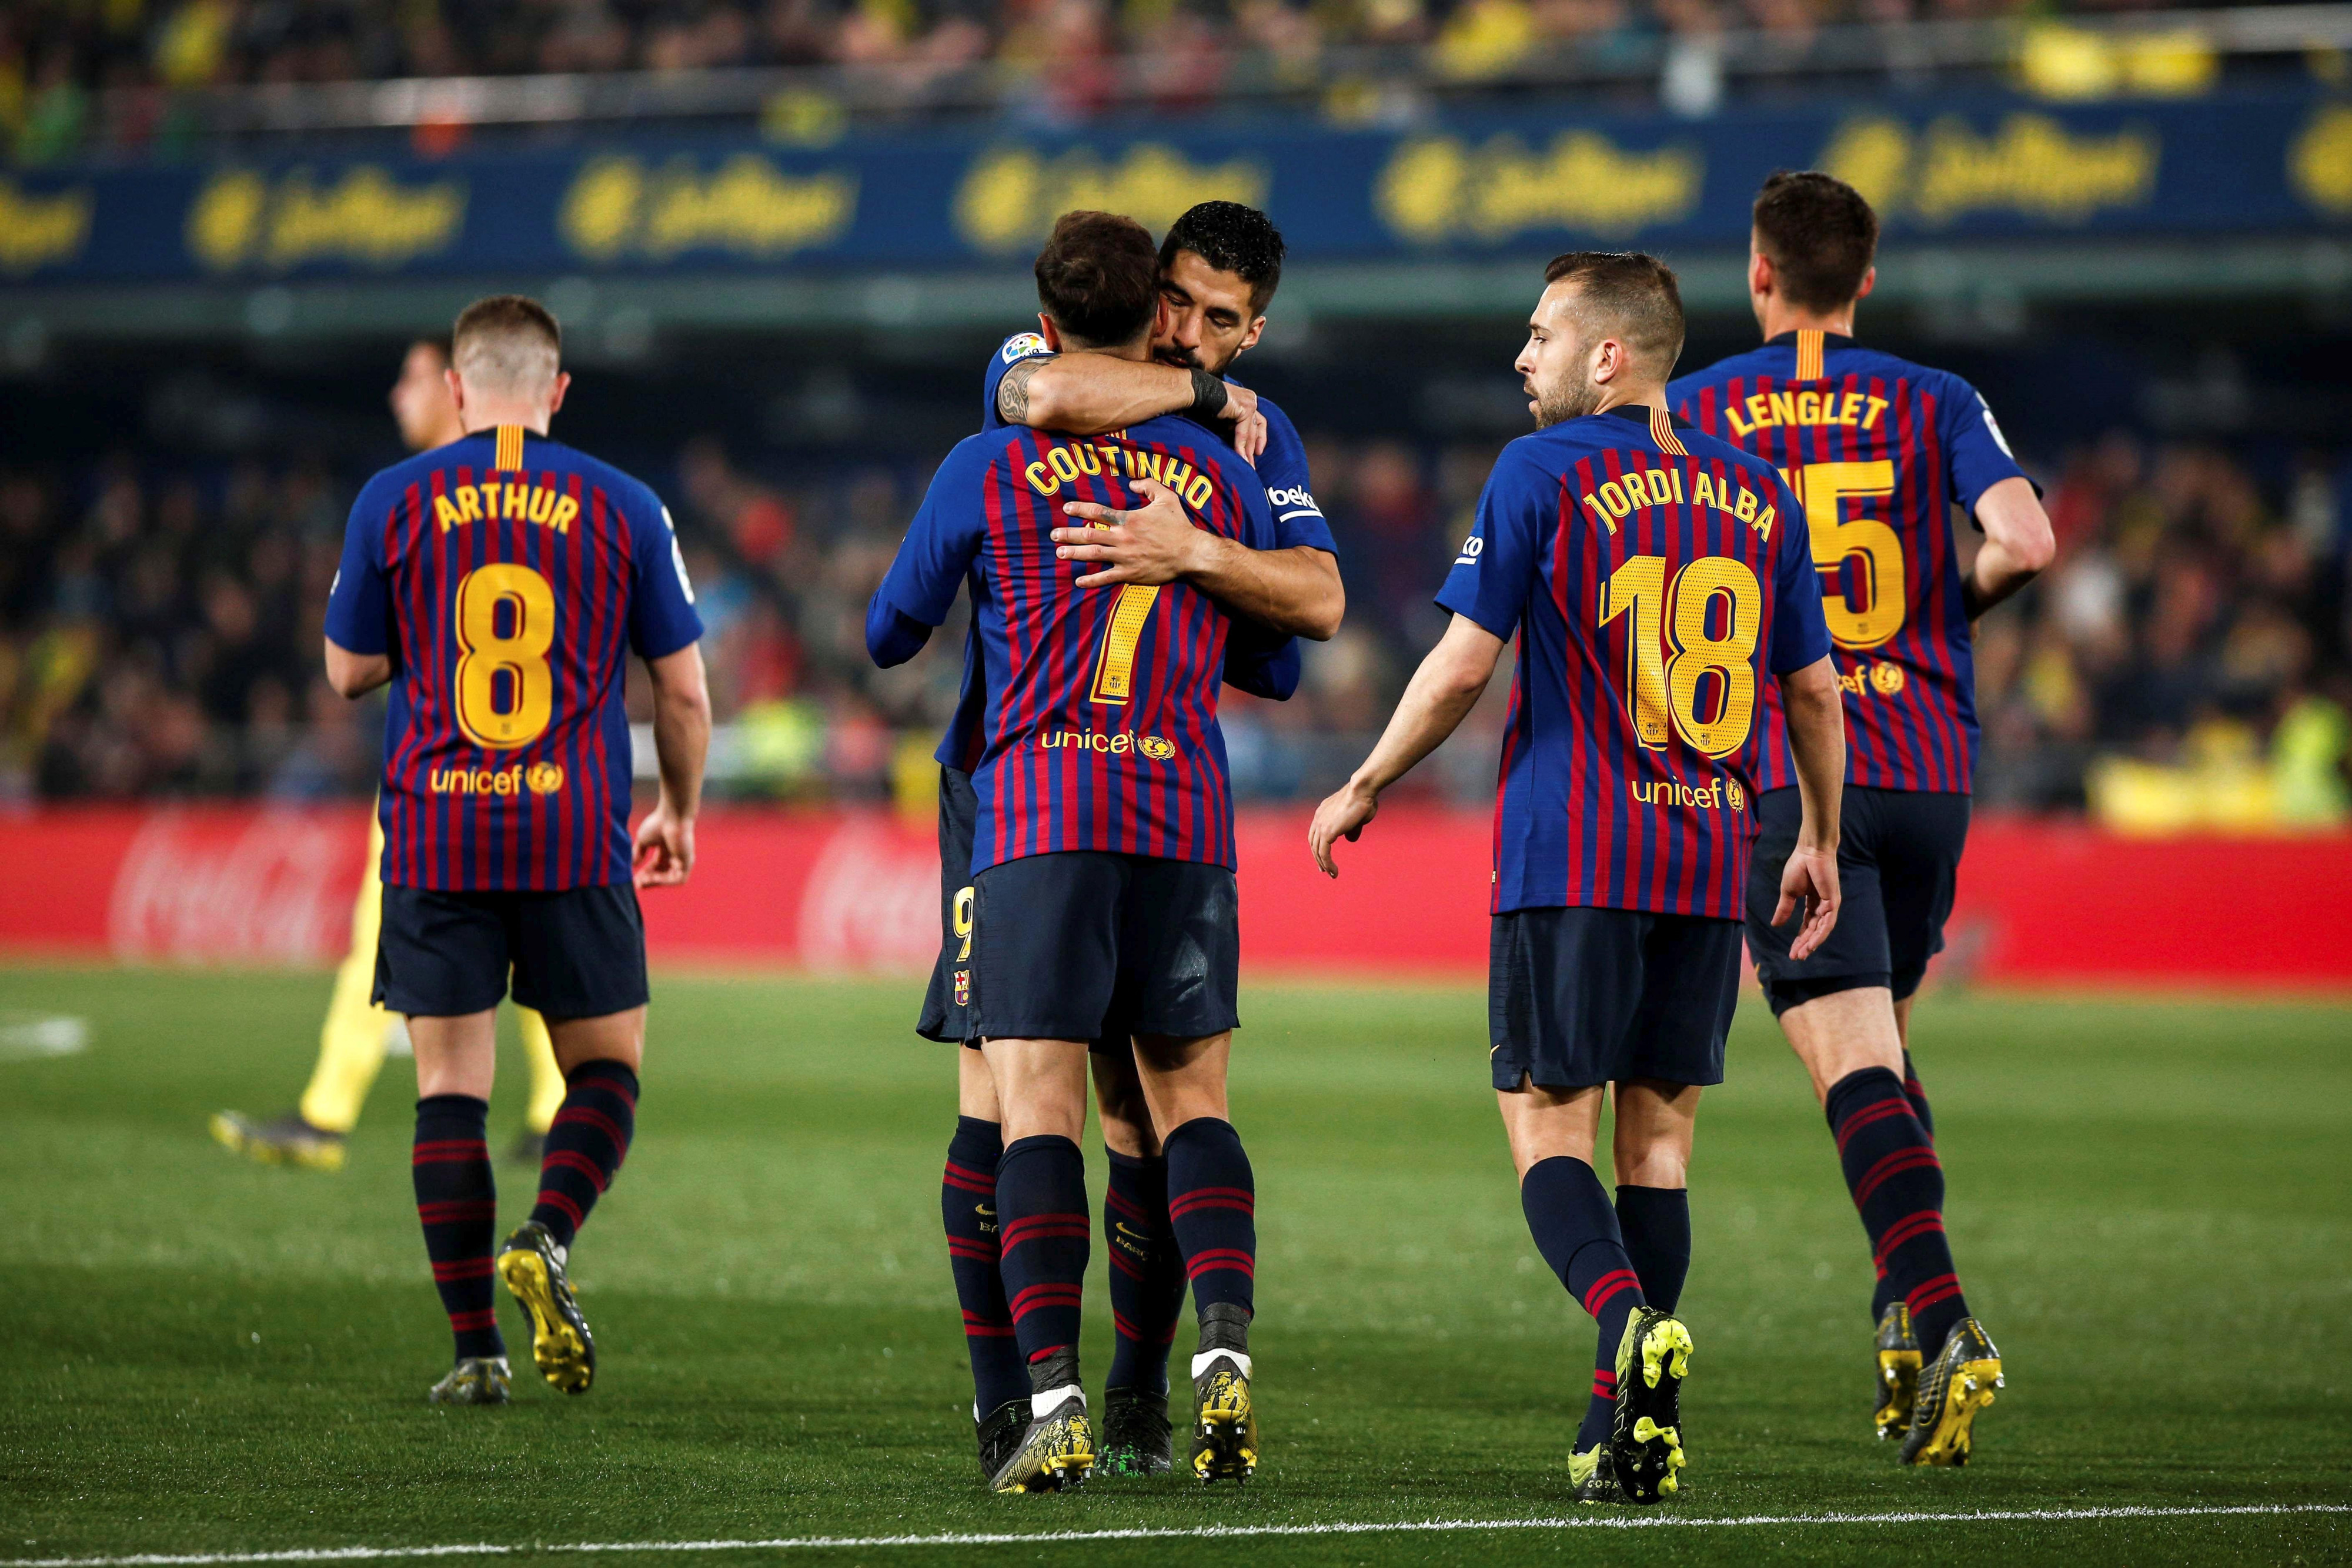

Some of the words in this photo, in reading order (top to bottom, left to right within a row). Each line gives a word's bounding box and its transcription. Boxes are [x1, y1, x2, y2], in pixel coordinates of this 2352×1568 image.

[1725, 391, 1889, 437] LENGLET
[1025, 443, 1213, 510] COUTINHO
[1583, 468, 1683, 536] JORDI
[1692, 472, 1776, 543] ALBA
[433, 483, 580, 534] ARTHUR
[1777, 460, 1906, 649] 5
[455, 563, 555, 749] 8
[1598, 555, 1762, 761] 18
[1041, 727, 1135, 754] unicef
[430, 764, 523, 795] unicef
[1631, 775, 1722, 809] unicef
[953, 887, 975, 962] 9
[1588, 1480, 1619, 1489] COPA
